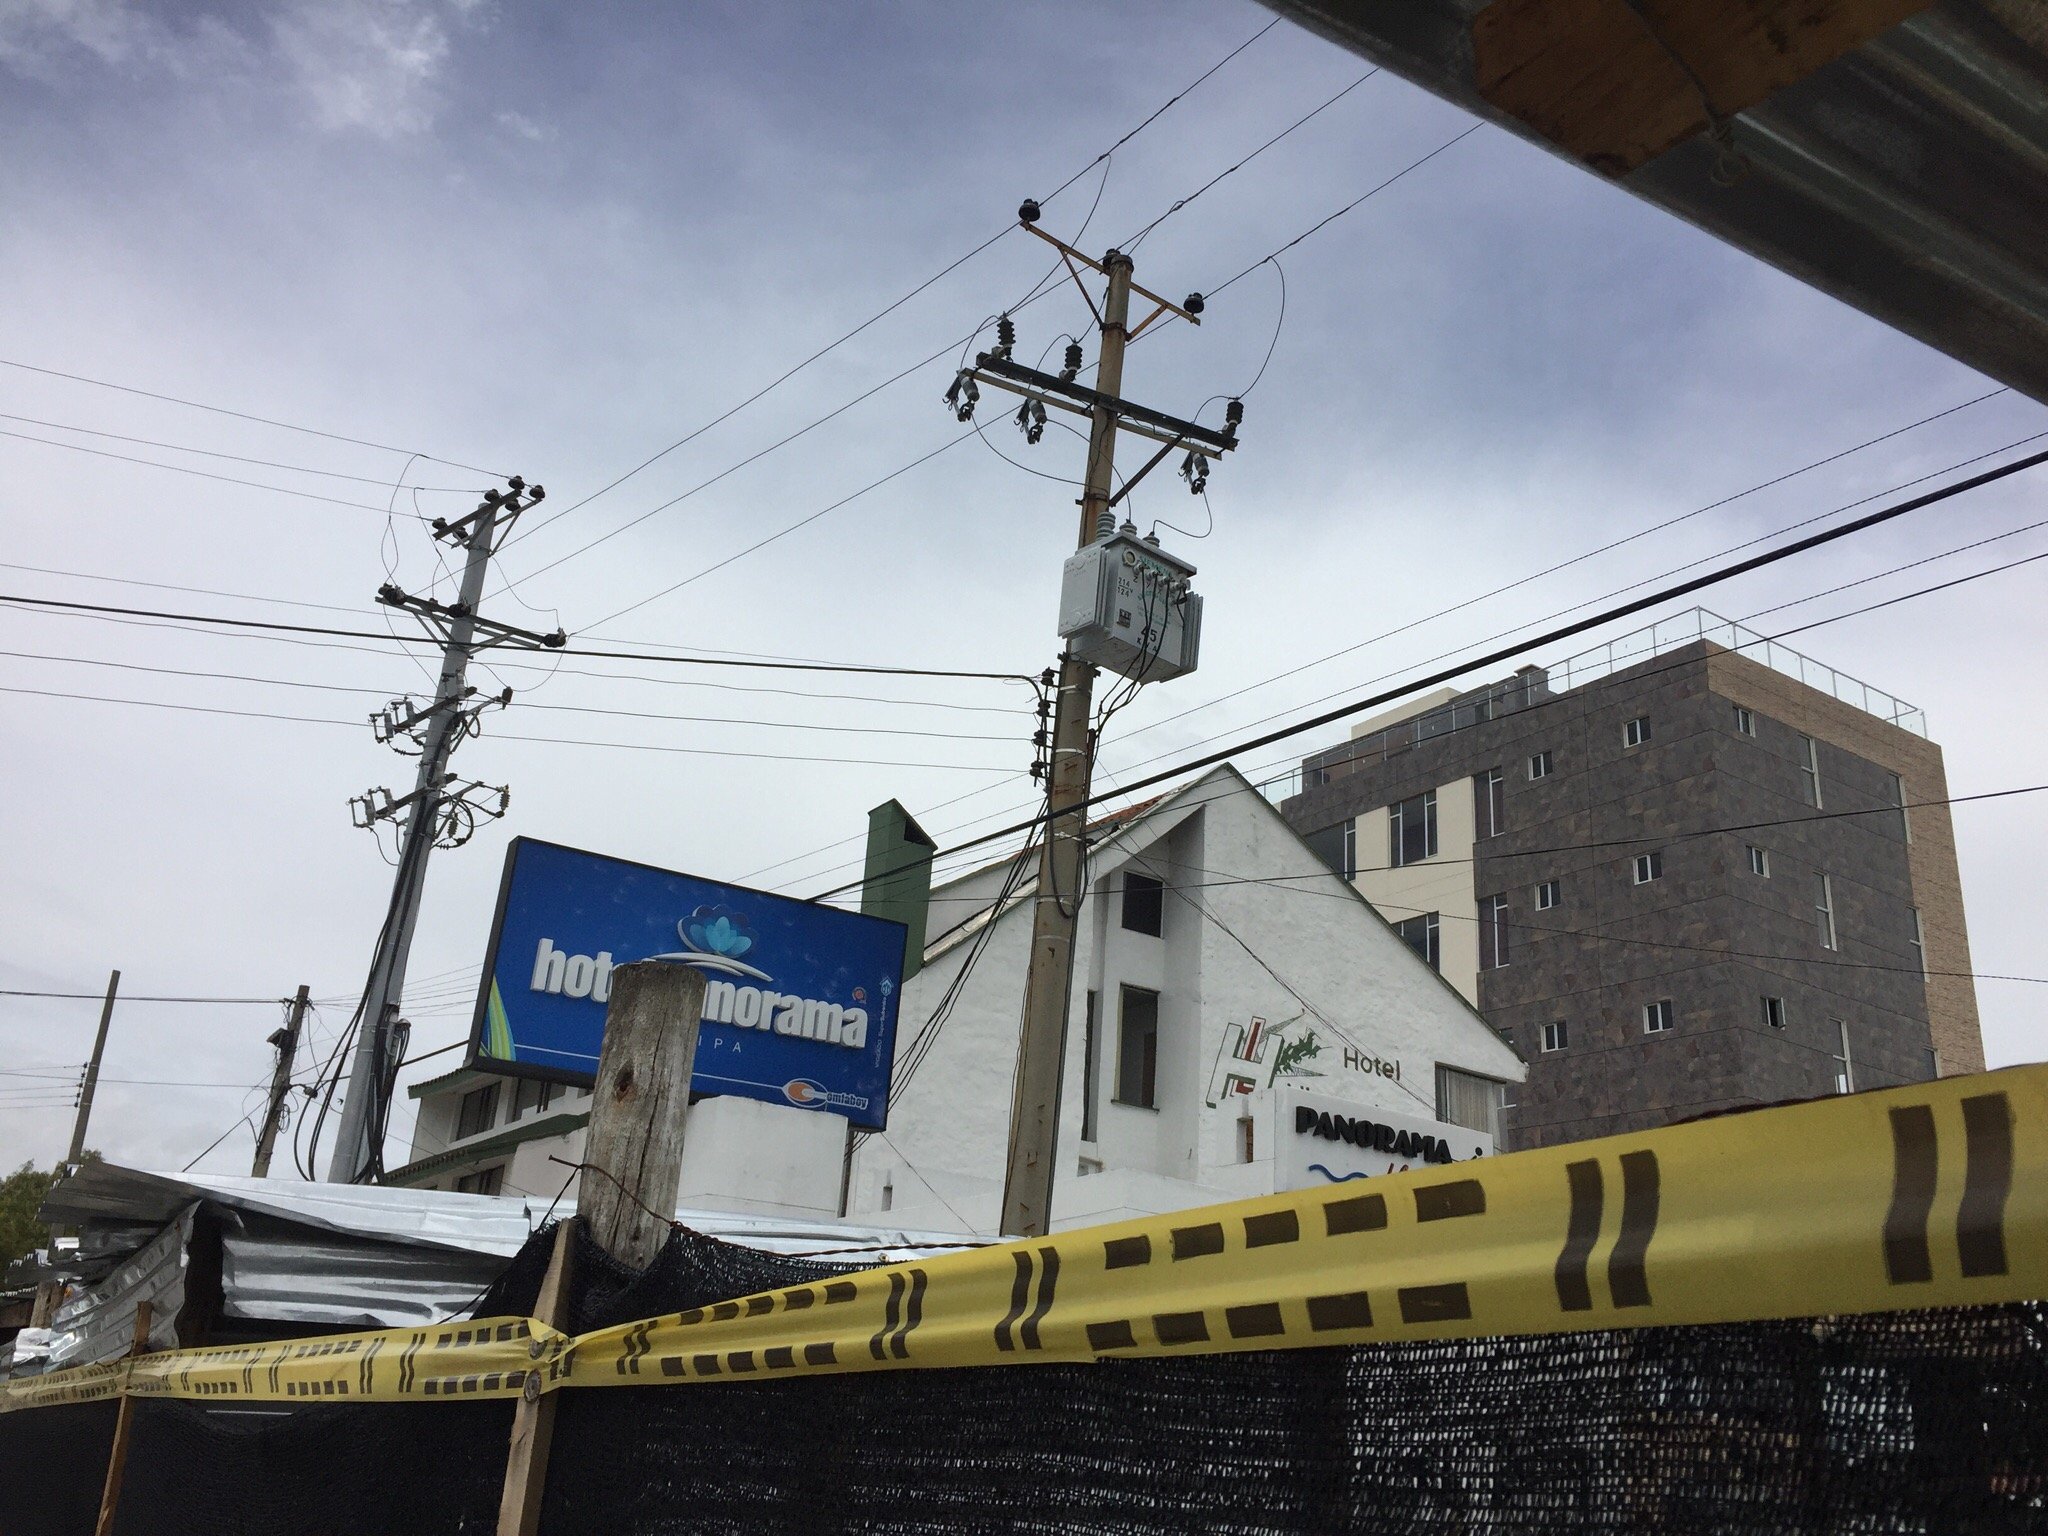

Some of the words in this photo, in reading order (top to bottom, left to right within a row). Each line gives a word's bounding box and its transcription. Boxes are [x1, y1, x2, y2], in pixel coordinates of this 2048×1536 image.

[701, 980, 868, 1049] norama
[697, 1034, 742, 1053] IPA
[1343, 1046, 1401, 1081] Hotel
[1295, 1105, 1453, 1164] PANORAMA
